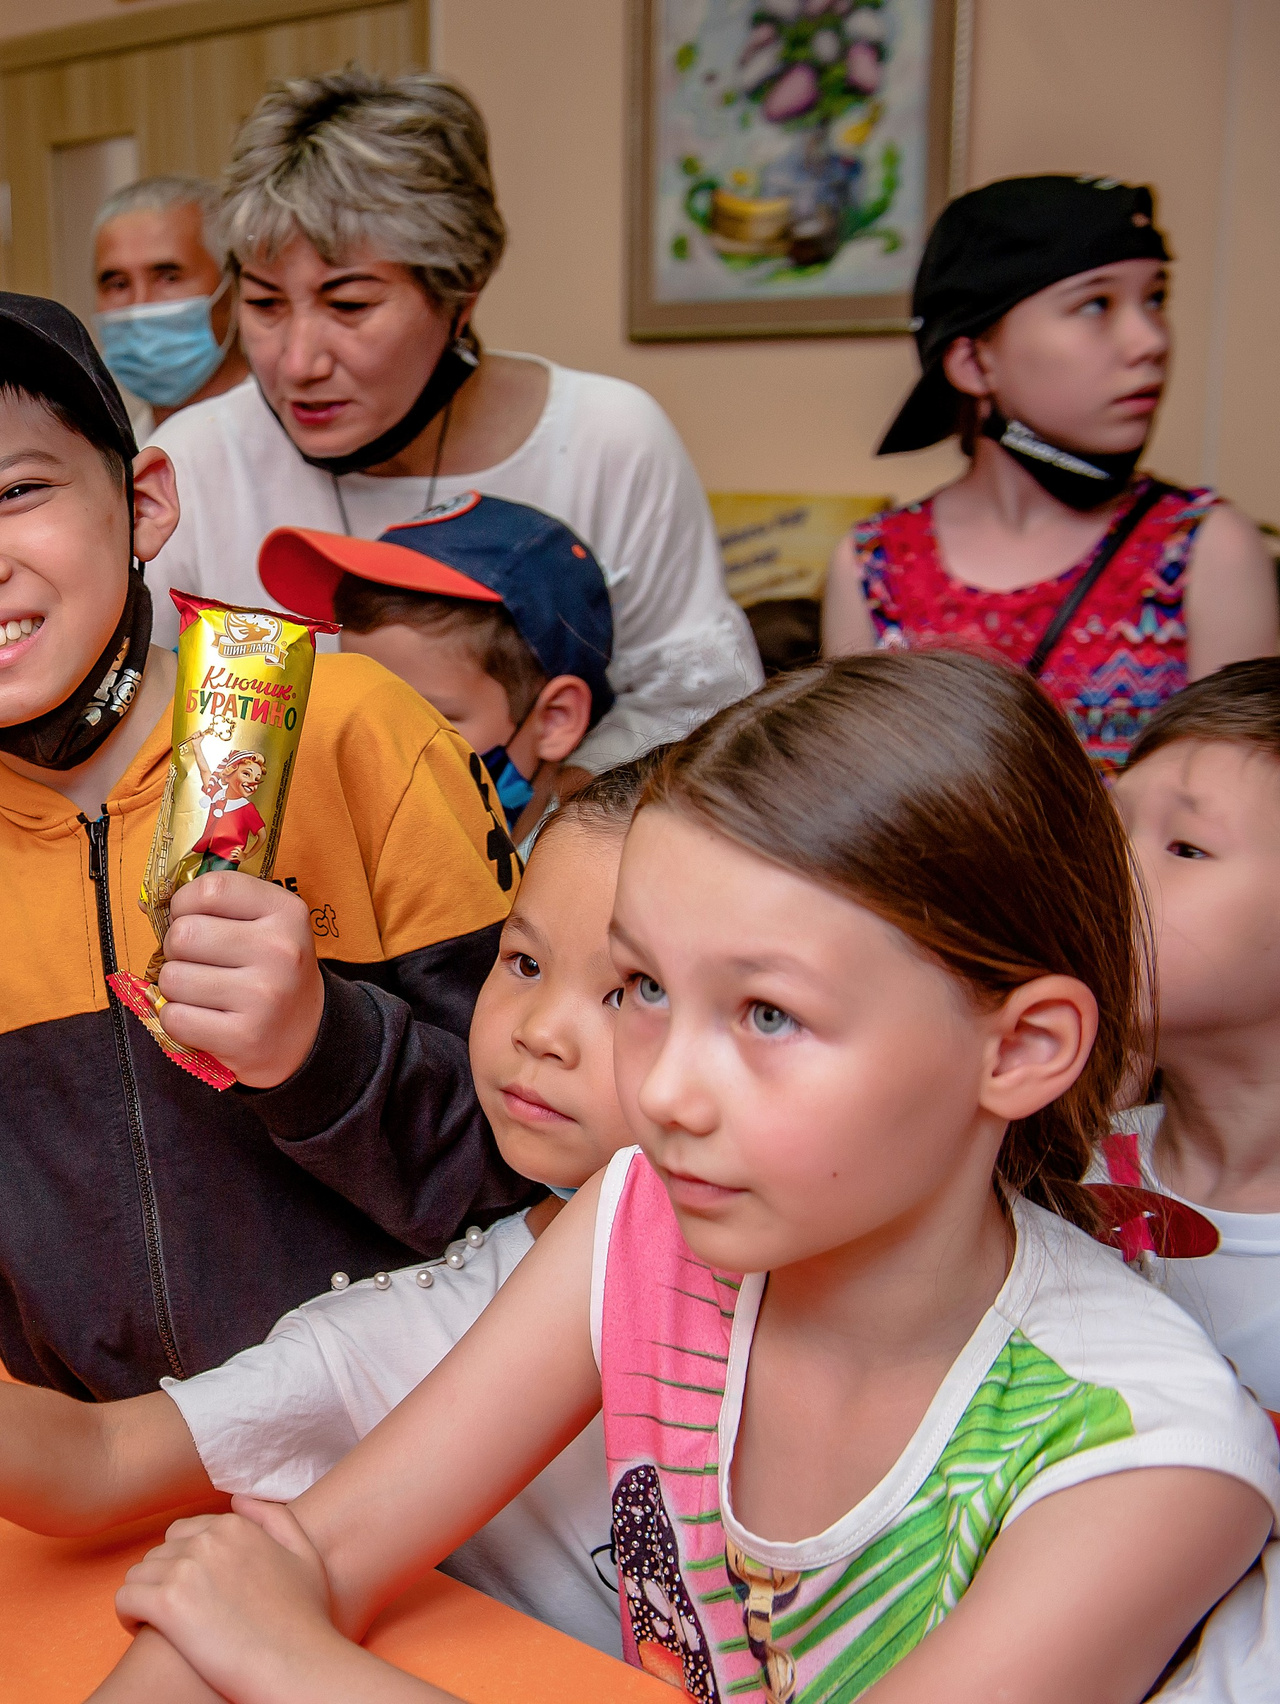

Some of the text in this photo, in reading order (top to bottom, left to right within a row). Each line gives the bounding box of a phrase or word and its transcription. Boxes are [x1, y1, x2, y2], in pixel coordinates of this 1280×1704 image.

[201, 665, 294, 701] Ключик
[185, 689, 297, 731] БУРАТИНО
[310, 903, 340, 938] ct
